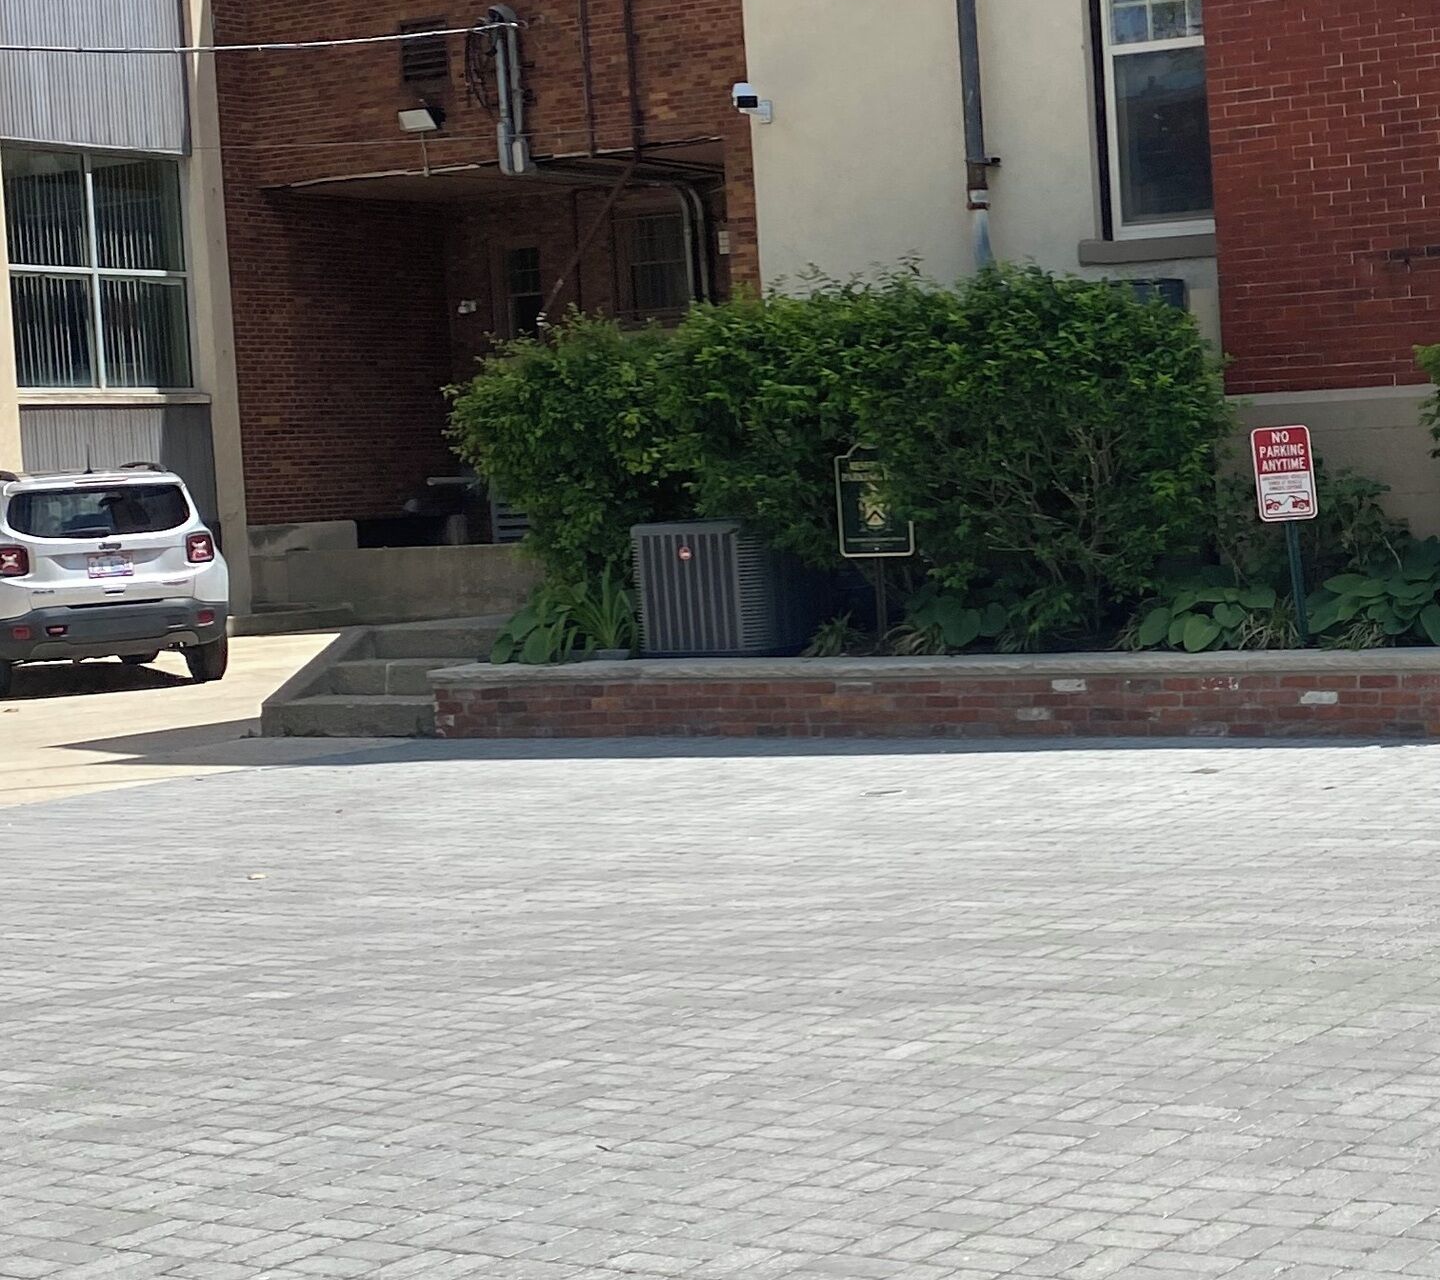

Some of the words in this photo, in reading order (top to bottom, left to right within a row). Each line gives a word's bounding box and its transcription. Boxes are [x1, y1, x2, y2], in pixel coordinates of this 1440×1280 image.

[1271, 431, 1290, 443] NO
[1259, 444, 1305, 459] PARKING
[1262, 457, 1306, 472] ANYTIME
